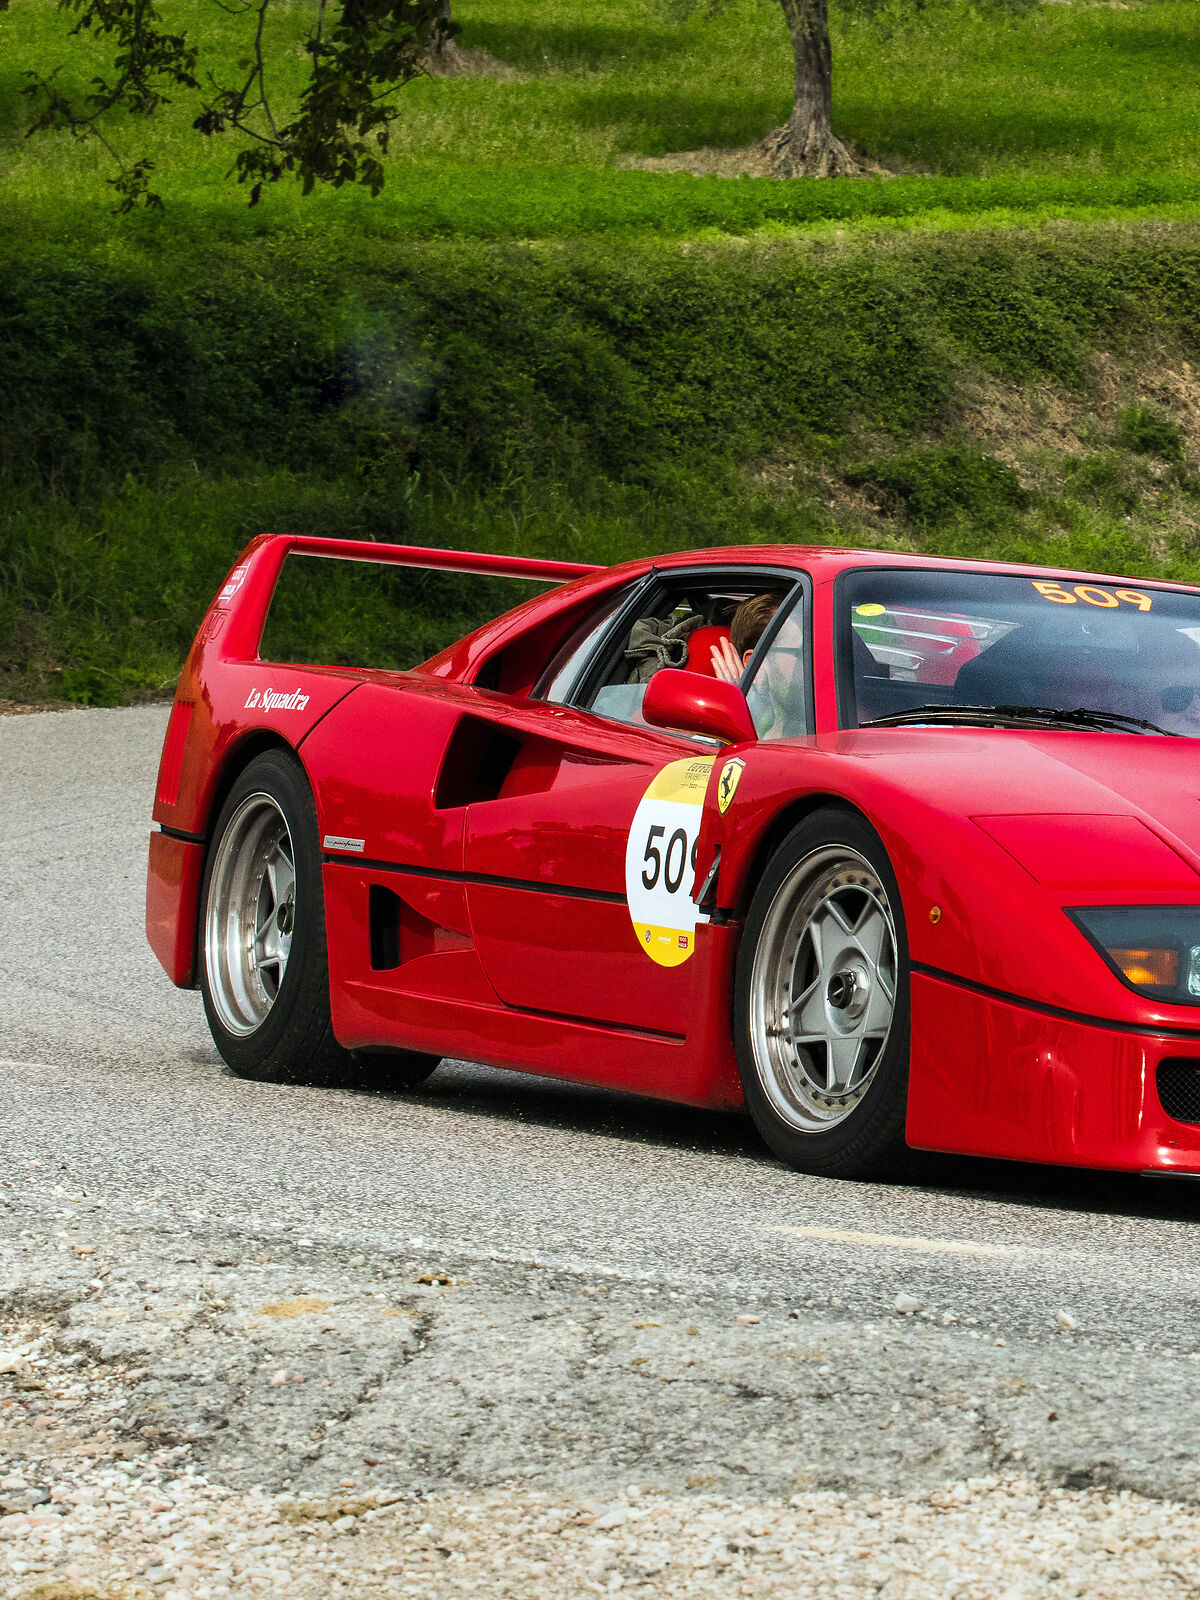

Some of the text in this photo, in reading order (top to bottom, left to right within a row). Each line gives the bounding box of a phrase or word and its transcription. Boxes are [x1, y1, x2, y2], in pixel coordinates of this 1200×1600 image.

[1031, 581, 1152, 611] 509
[243, 687, 310, 713] La Squadra
[687, 762, 713, 774] Ferrar
[641, 824, 698, 897] 50
